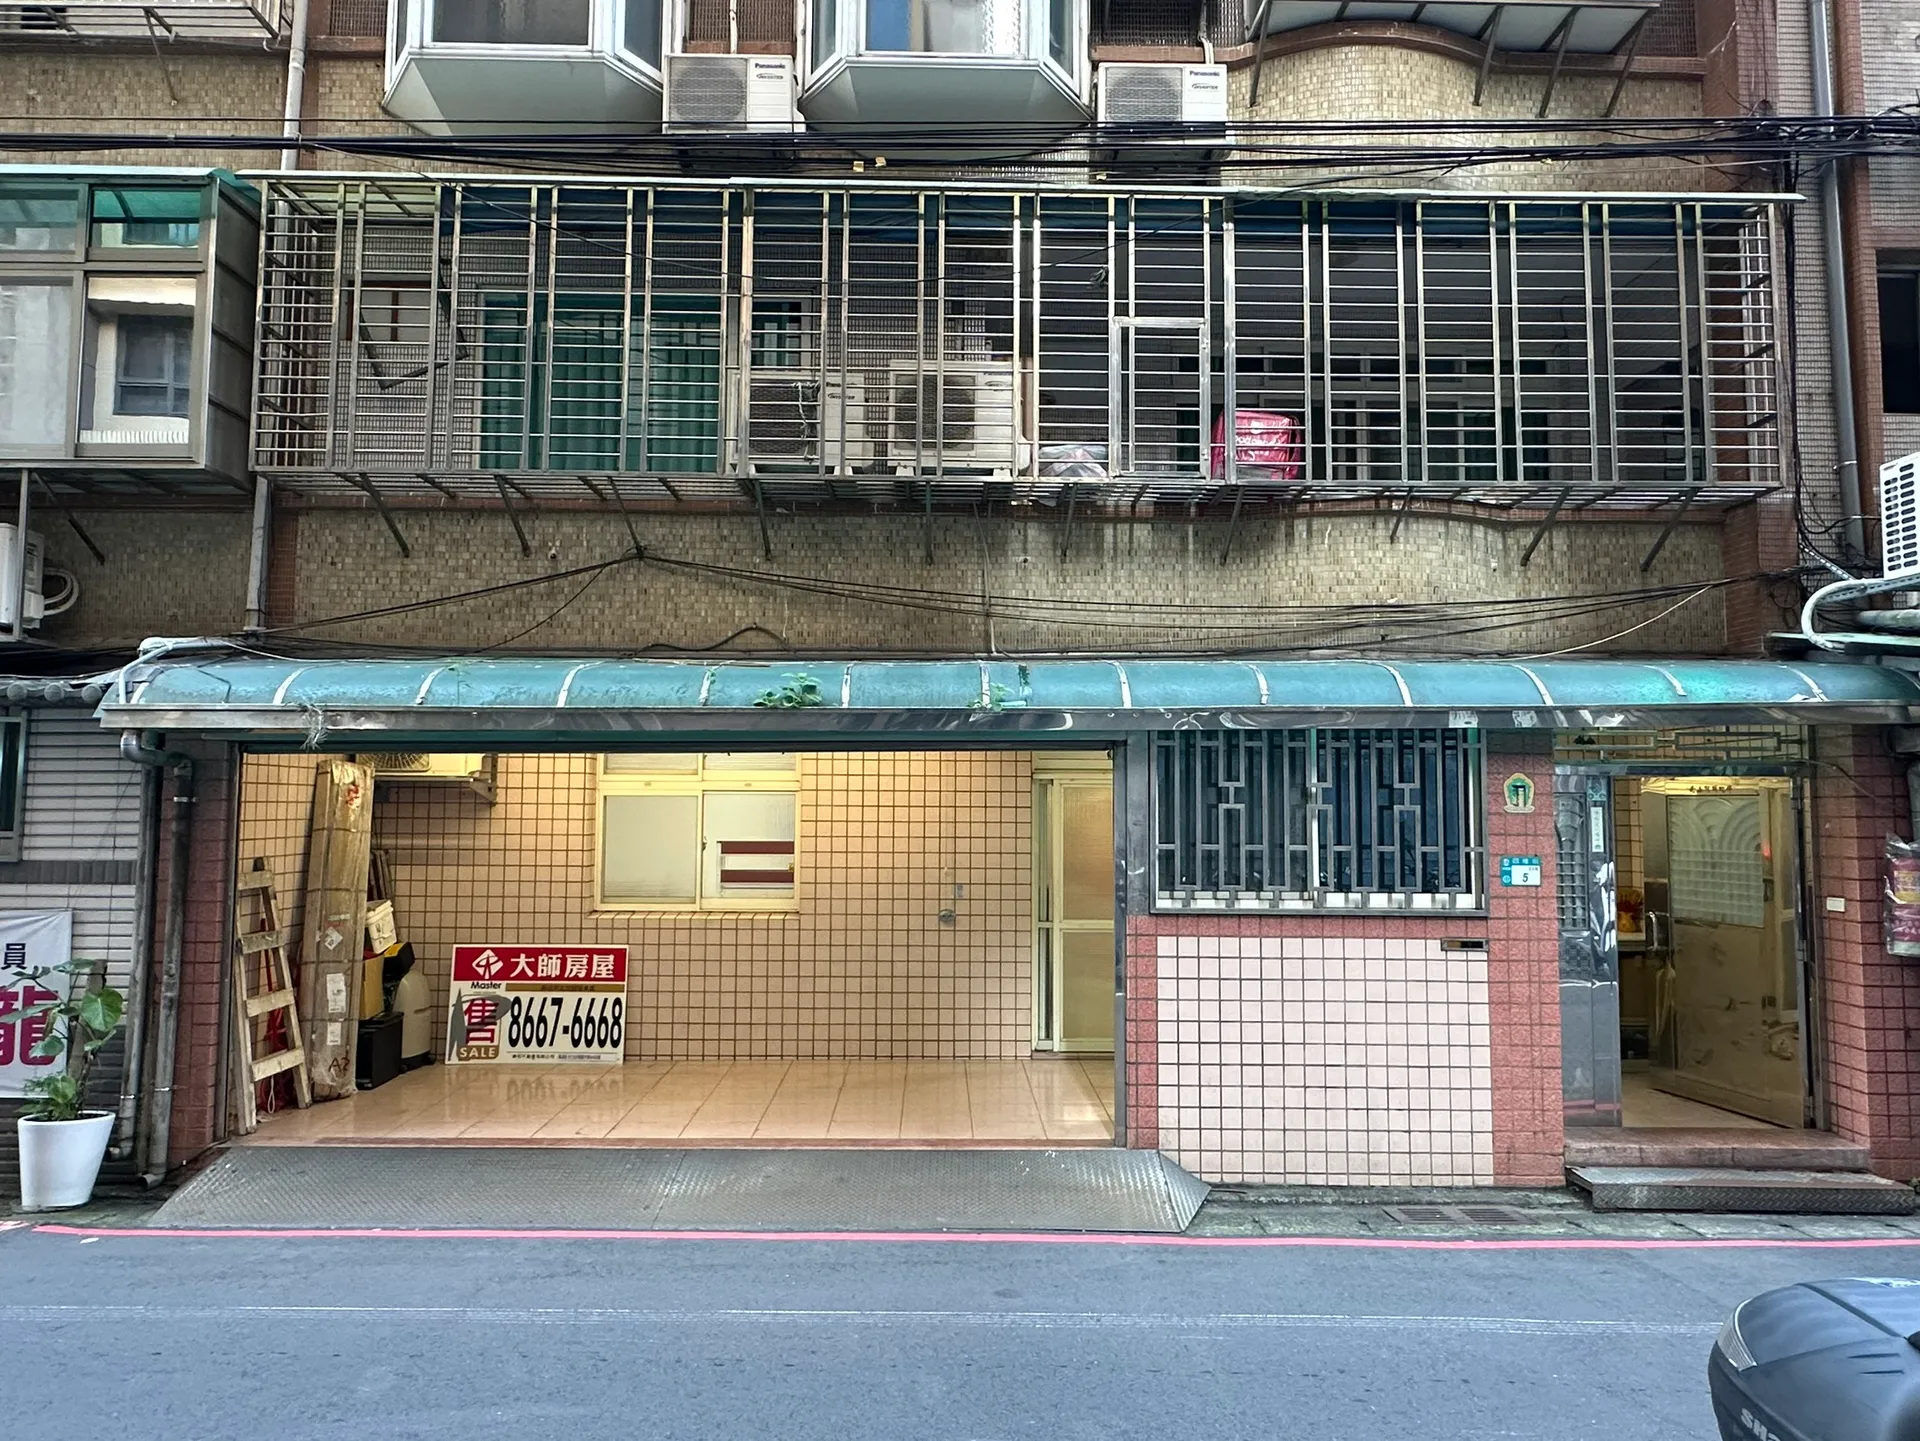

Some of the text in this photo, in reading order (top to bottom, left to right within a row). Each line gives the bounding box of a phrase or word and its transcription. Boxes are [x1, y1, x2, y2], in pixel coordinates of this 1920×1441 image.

[1522, 872, 1529, 883] 5
[1, 943, 27, 970] 員
[509, 952, 616, 980] 大師房屋
[470, 980, 502, 991] Master
[464, 997, 500, 1045] 售
[508, 995, 624, 1049] 8667-6668
[459, 1046, 497, 1059] SALE
